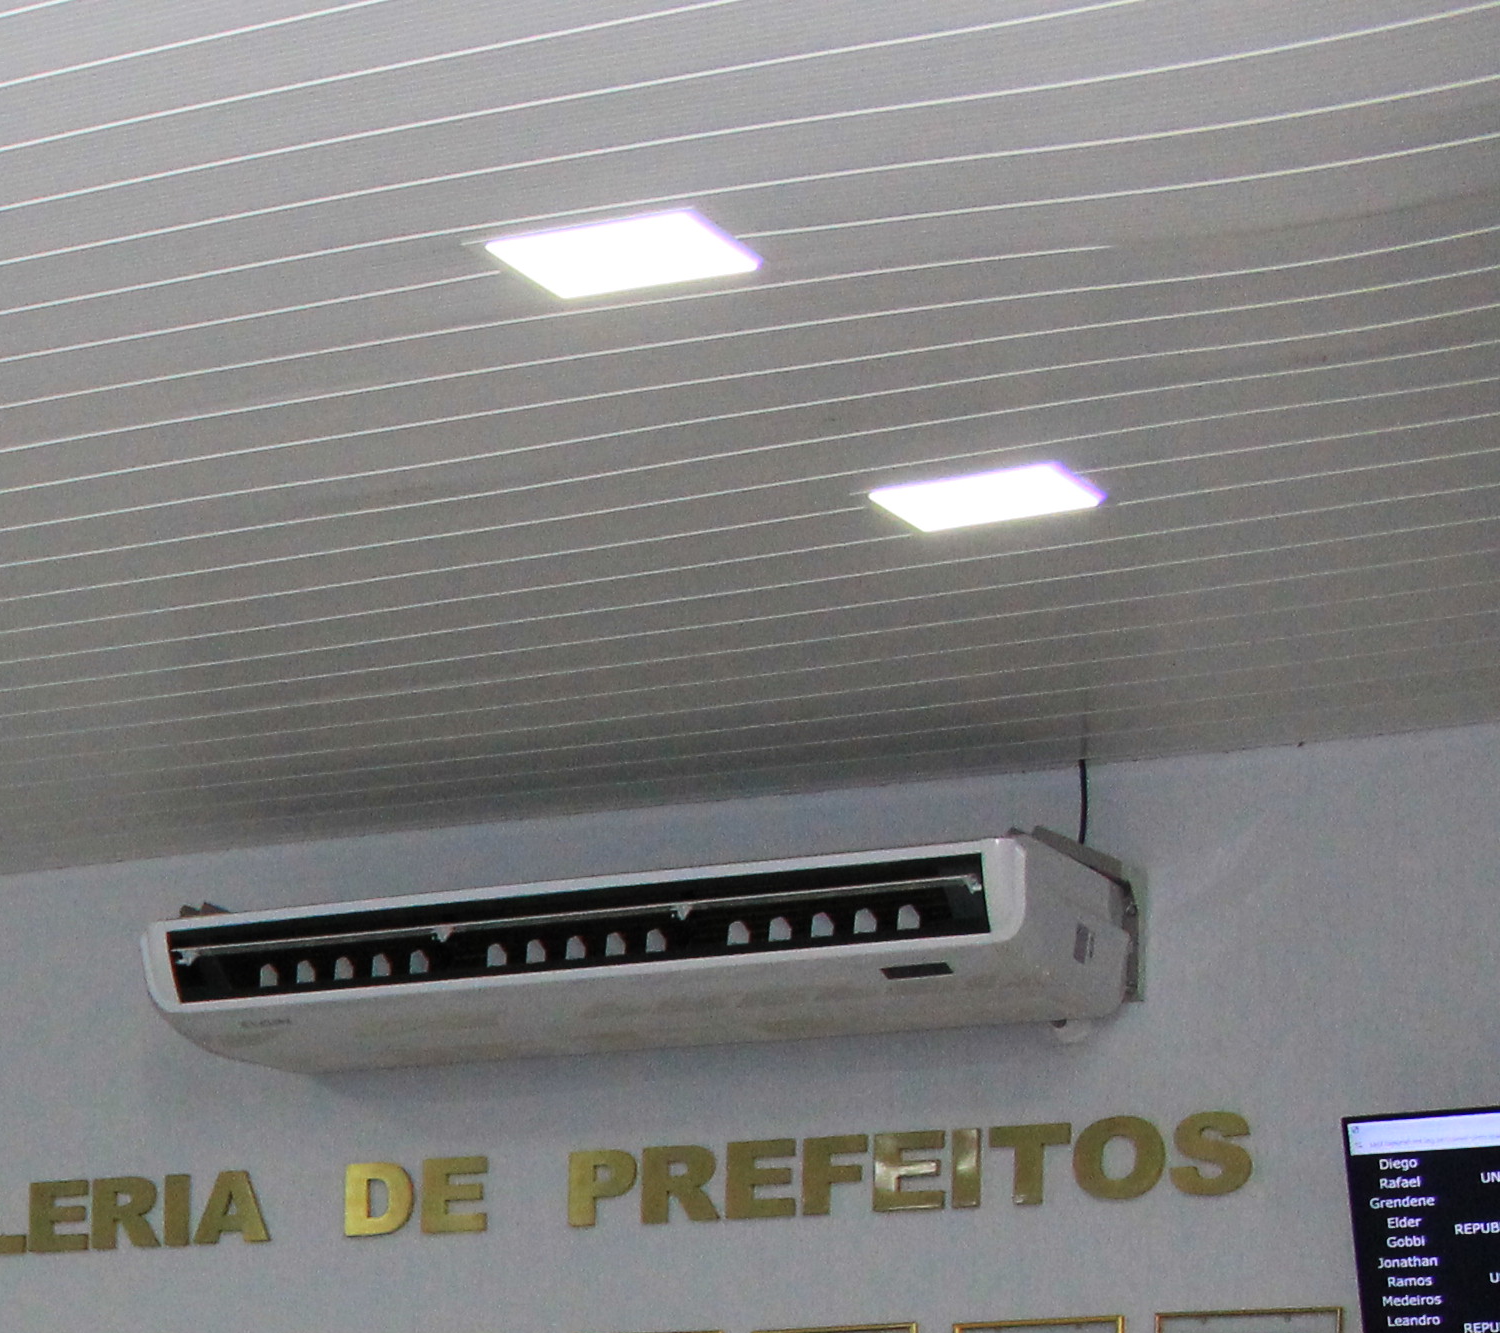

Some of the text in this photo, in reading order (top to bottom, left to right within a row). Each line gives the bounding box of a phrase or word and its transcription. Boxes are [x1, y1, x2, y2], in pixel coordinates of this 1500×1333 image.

[1378, 1157, 1419, 1171] Diego
[343, 1155, 489, 1238] DE
[566, 1111, 1253, 1229] PREFEITOS
[1378, 1175, 1422, 1189] Rafael
[1369, 1195, 1436, 1209] Grendene
[1386, 1215, 1422, 1229] Elder
[1385, 1234, 1426, 1248] Gobbi
[1377, 1254, 1439, 1269] Jonathan
[1386, 1275, 1433, 1288] Ramos
[1381, 1293, 1443, 1307] Medeiros
[1386, 1313, 1441, 1327] Leandro
